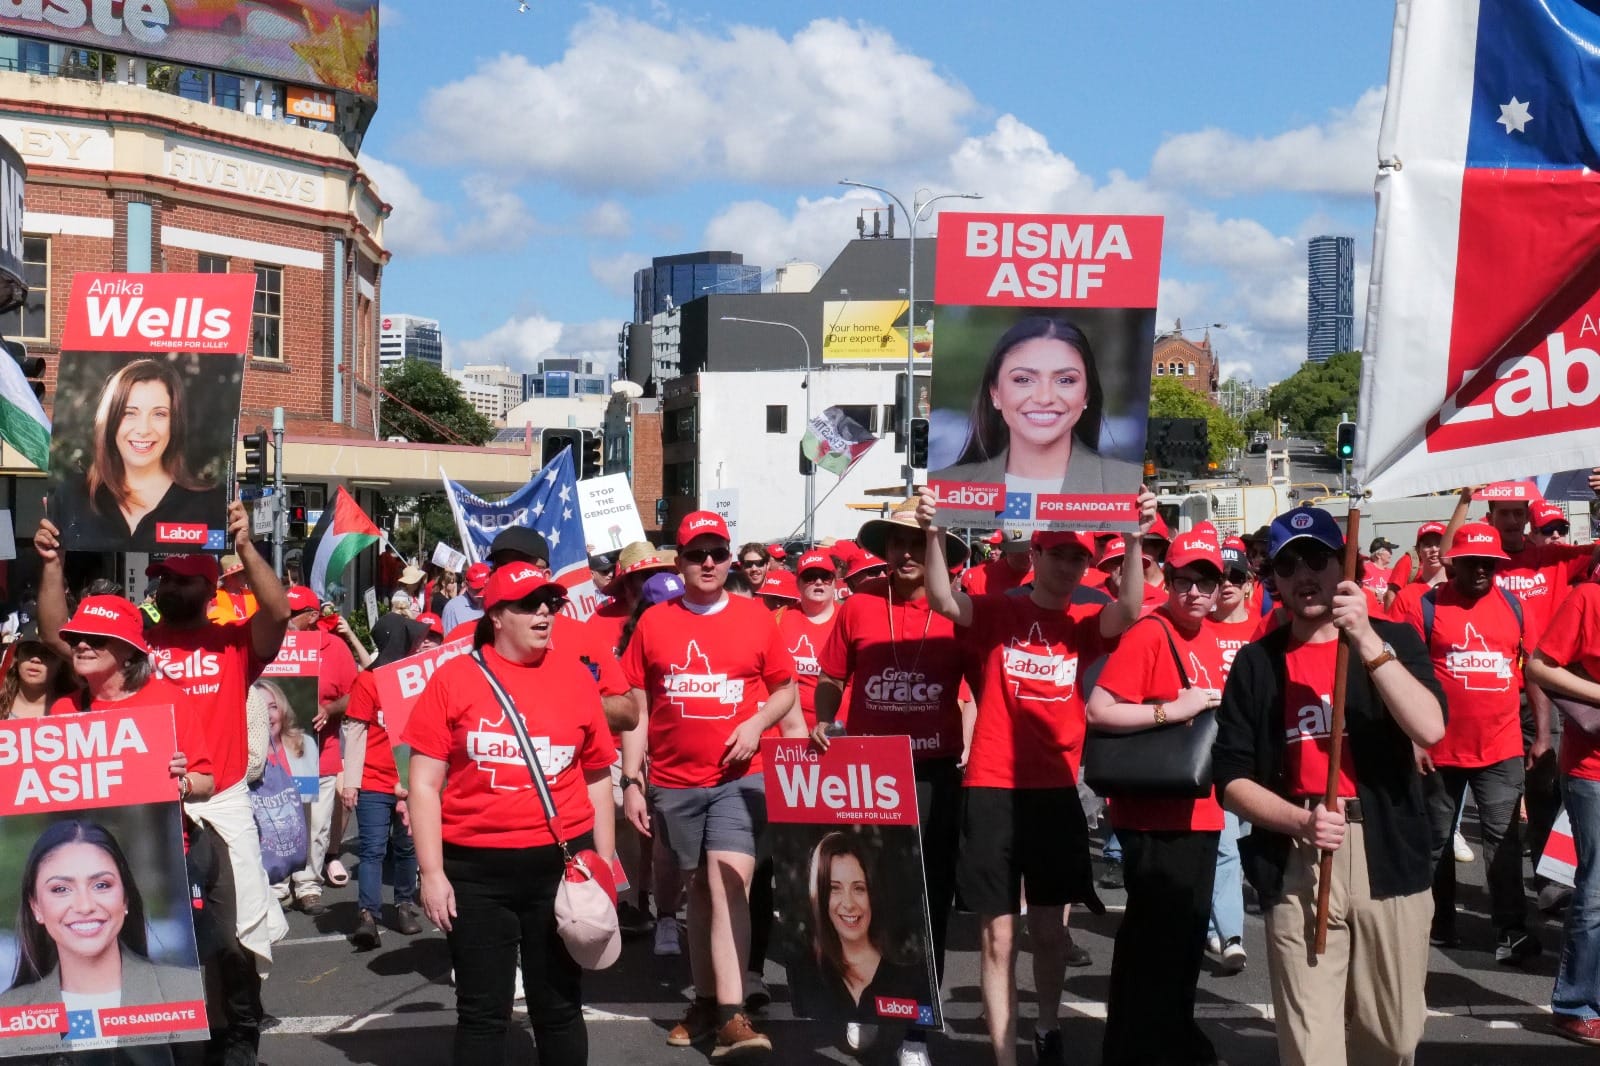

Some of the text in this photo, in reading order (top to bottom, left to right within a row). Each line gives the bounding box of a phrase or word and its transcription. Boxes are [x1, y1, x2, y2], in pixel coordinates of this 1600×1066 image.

[20, 127, 93, 160] EY
[168, 149, 317, 203] FIVEWAYS
[966, 222, 1132, 260] BISMA
[88, 278, 144, 296] Anika
[987, 263, 1106, 299] ASIF
[86, 296, 231, 339] Wells
[829, 323, 882, 333] Your home.
[150, 340, 229, 349] MEMBER FOR LILLEY
[829, 334, 846, 344] Our
[589, 487, 615, 498] STOP
[934, 484, 1131, 512] Labor FOR SANDGATE
[1481, 485, 1512, 497] Labor
[596, 497, 615, 507] THE
[583, 503, 633, 519] GENOCIDE
[1540, 510, 1562, 519] Labor
[689, 517, 719, 530] Labor
[159, 525, 203, 541] Labor
[1467, 533, 1494, 543] Labor
[1111, 541, 1126, 550] Lab
[1184, 539, 1216, 553] Labor
[802, 556, 824, 566] Labor
[1220, 549, 1239, 559] WU
[1495, 573, 1546, 591] Milton
[83, 604, 120, 622] Labor
[796, 660, 820, 673] bor
[1006, 656, 1059, 677] Labor
[1451, 654, 1499, 670] Labor
[882, 667, 926, 682] Grace
[192, 683, 220, 695] Lilley
[667, 678, 721, 694] Labor
[864, 675, 944, 702] Grace
[0, 718, 148, 767] BISMA
[774, 745, 819, 762] Anika
[14, 760, 122, 806] ASIF
[774, 763, 900, 809] Wells
[879, 812, 902, 820] LILLEY
[878, 999, 914, 1016] Labor
[0, 1009, 196, 1033] Labor FOR SANDGATE
